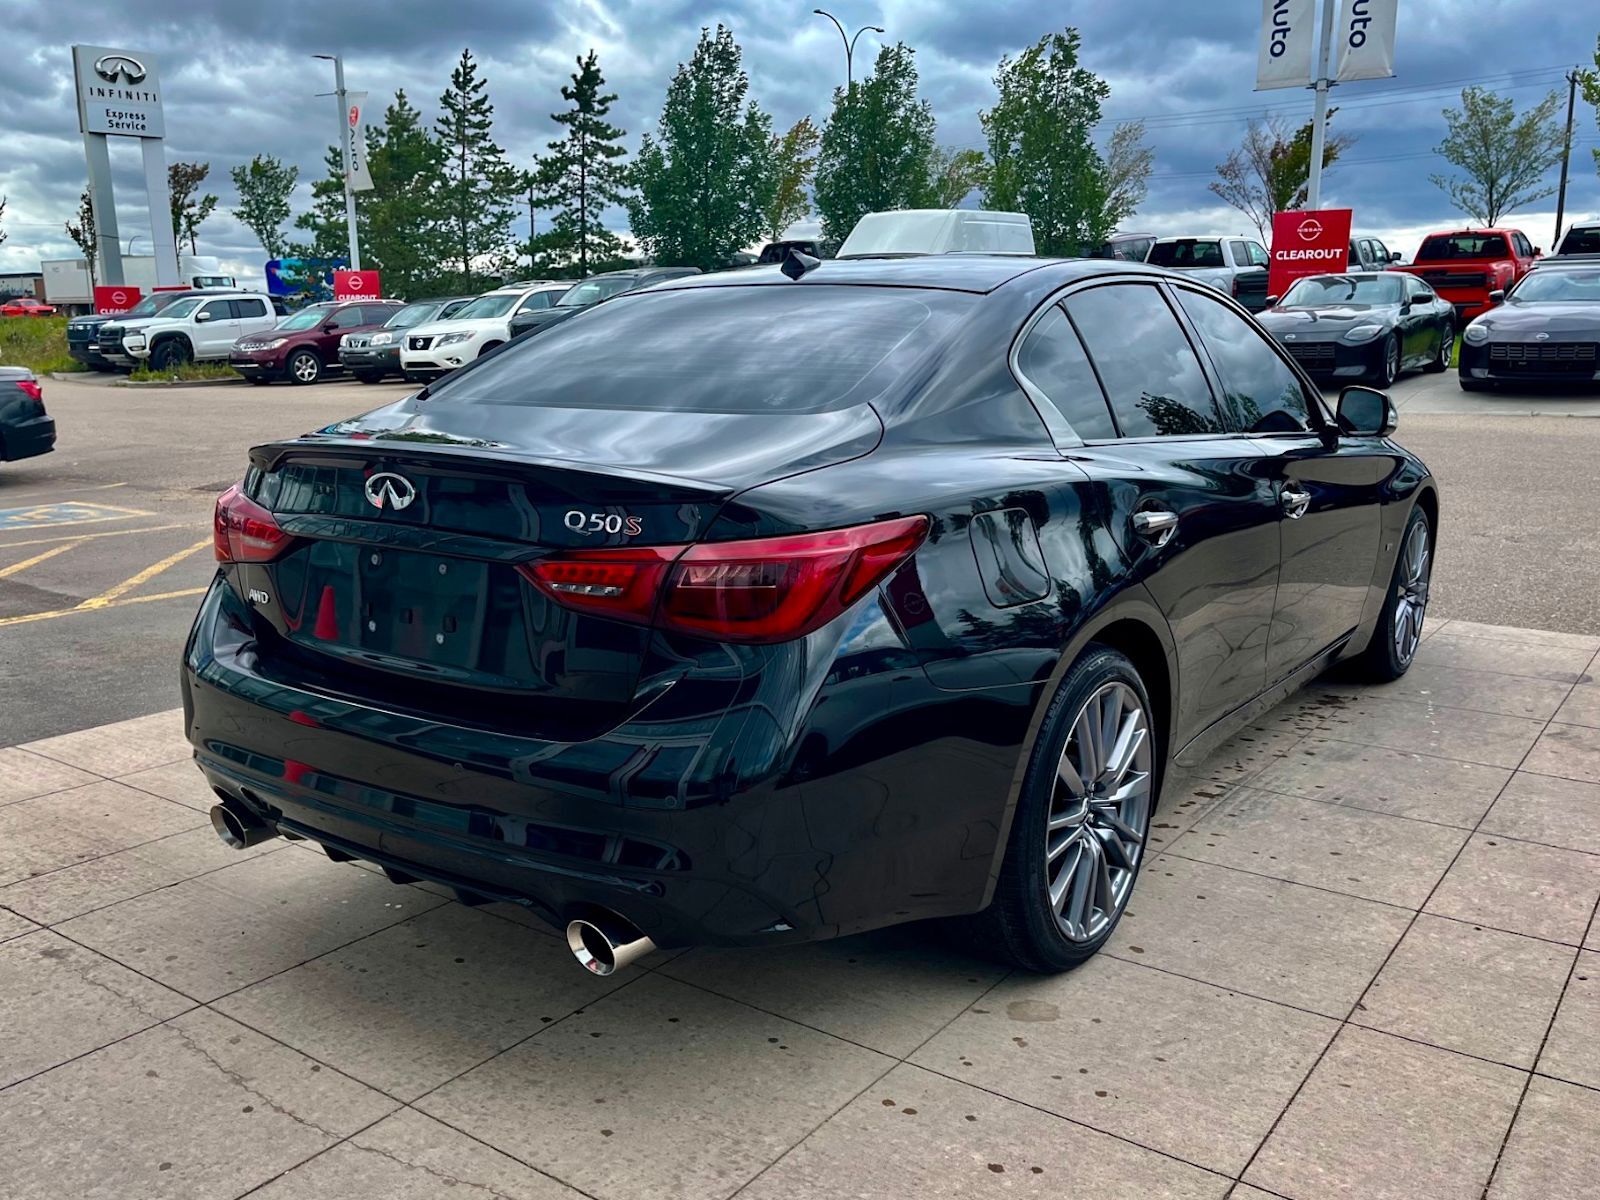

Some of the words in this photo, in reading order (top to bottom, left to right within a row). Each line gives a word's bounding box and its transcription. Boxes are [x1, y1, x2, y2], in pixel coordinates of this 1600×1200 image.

[89, 86, 157, 102] INFINITI
[105, 108, 146, 121] Express
[108, 120, 147, 131] Service
[1275, 248, 1343, 261] CLEAROUT
[248, 588, 269, 604] AWD
